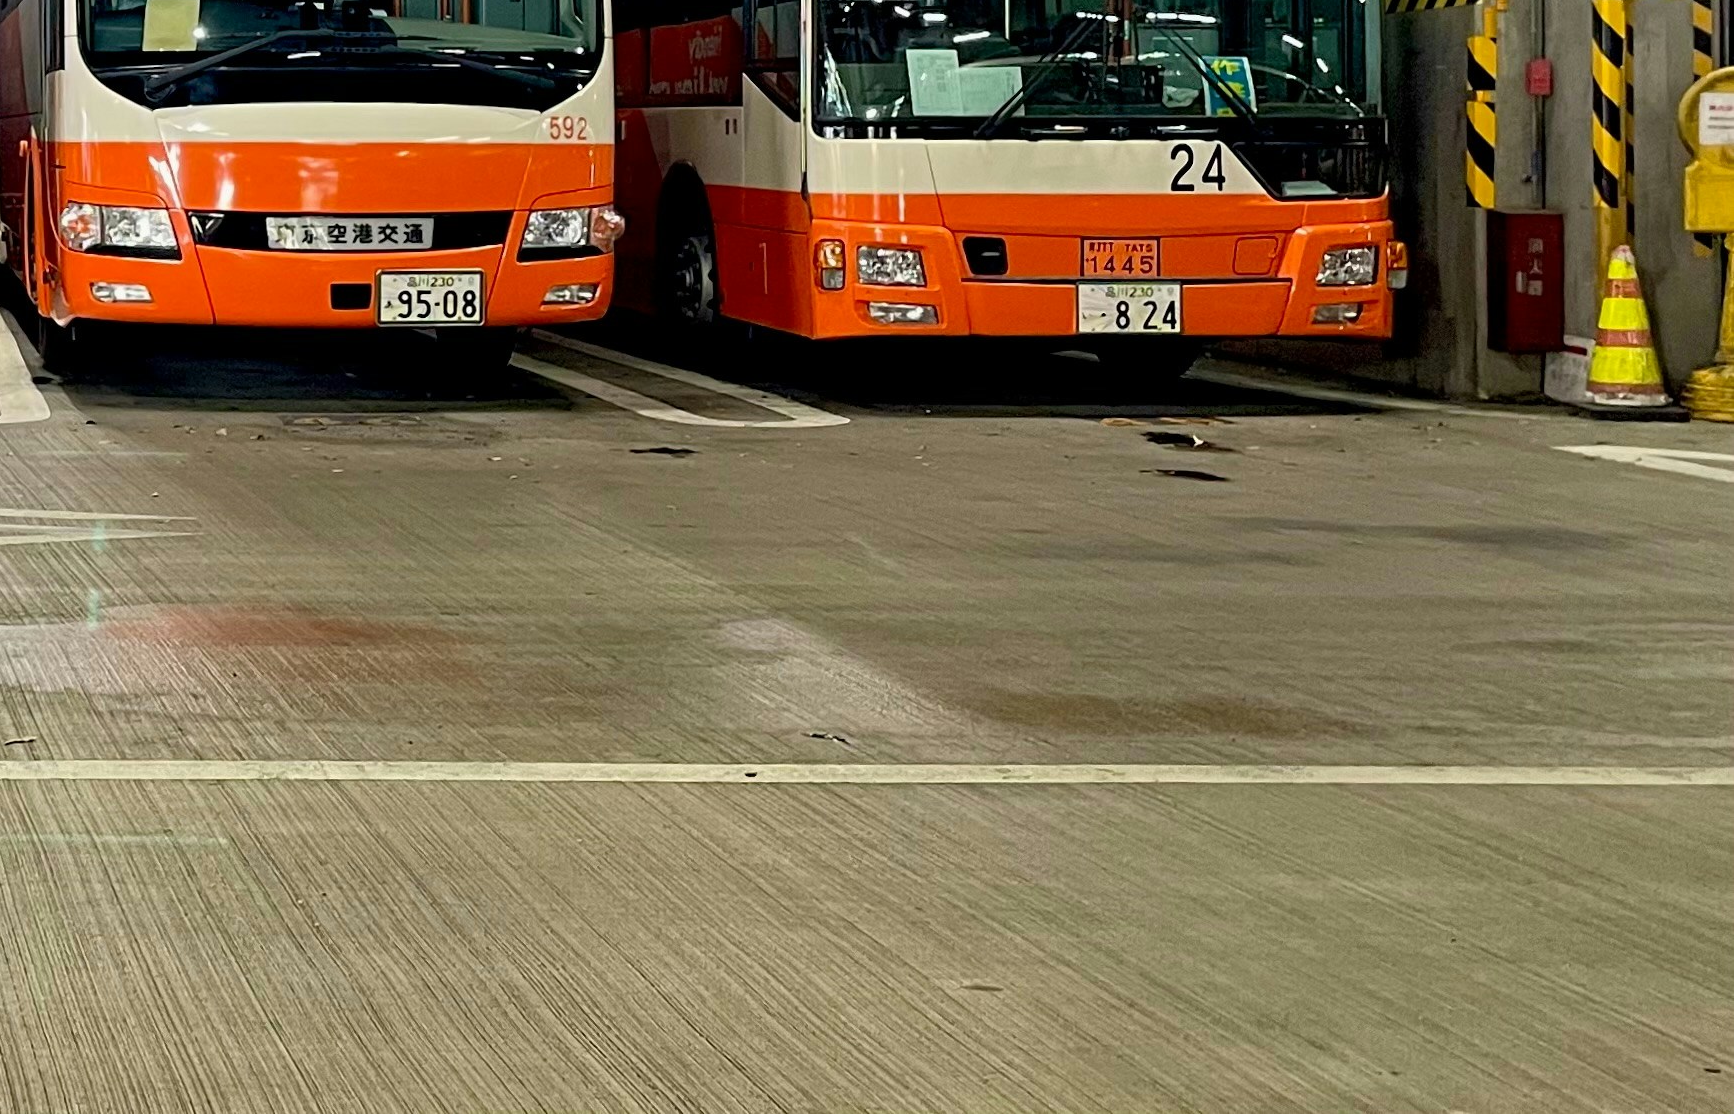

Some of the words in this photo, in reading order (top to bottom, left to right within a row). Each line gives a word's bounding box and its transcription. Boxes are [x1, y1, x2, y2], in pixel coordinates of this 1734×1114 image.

[549, 115, 588, 141] 592
[1170, 143, 1226, 192] 24
[1089, 255, 1154, 275] 1445
[397, 290, 477, 319] 95-08
